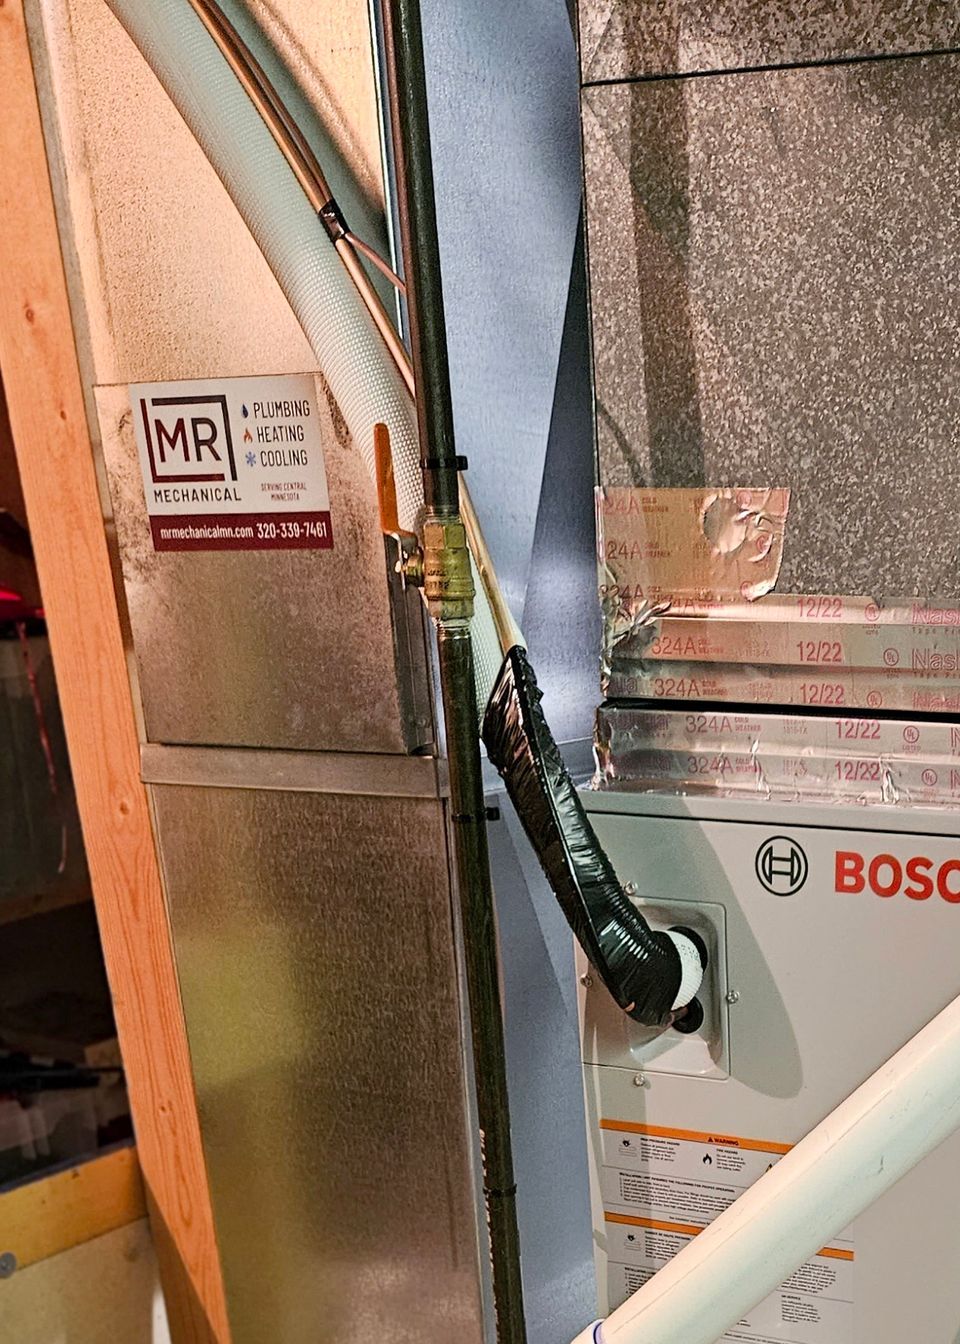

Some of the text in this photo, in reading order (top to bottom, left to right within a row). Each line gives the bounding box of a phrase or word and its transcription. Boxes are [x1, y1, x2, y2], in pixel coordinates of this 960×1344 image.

[253, 400, 310, 419] PLUMBING
[154, 417, 222, 463] MR
[256, 425, 305, 443] HEATING
[260, 450, 308, 467] COOLING
[154, 488, 242, 502] MECHANICAL
[284, 482, 307, 490] CENTRAL
[271, 492, 299, 500] MINNESOTA
[160, 521, 327, 539] mrmechanicalmn.com 320-339-7461
[797, 597, 842, 618] 12/22
[652, 637, 696, 655] 324A
[797, 641, 842, 663] 12/22
[654, 678, 700, 697] 324A
[799, 683, 844, 705] 12/22
[686, 715, 732, 733] 324A
[835, 719, 881, 740] 12/22
[687, 756, 733, 774] 324A
[835, 760, 880, 781] 12/22
[714, 1137, 739, 1146] WARNING
